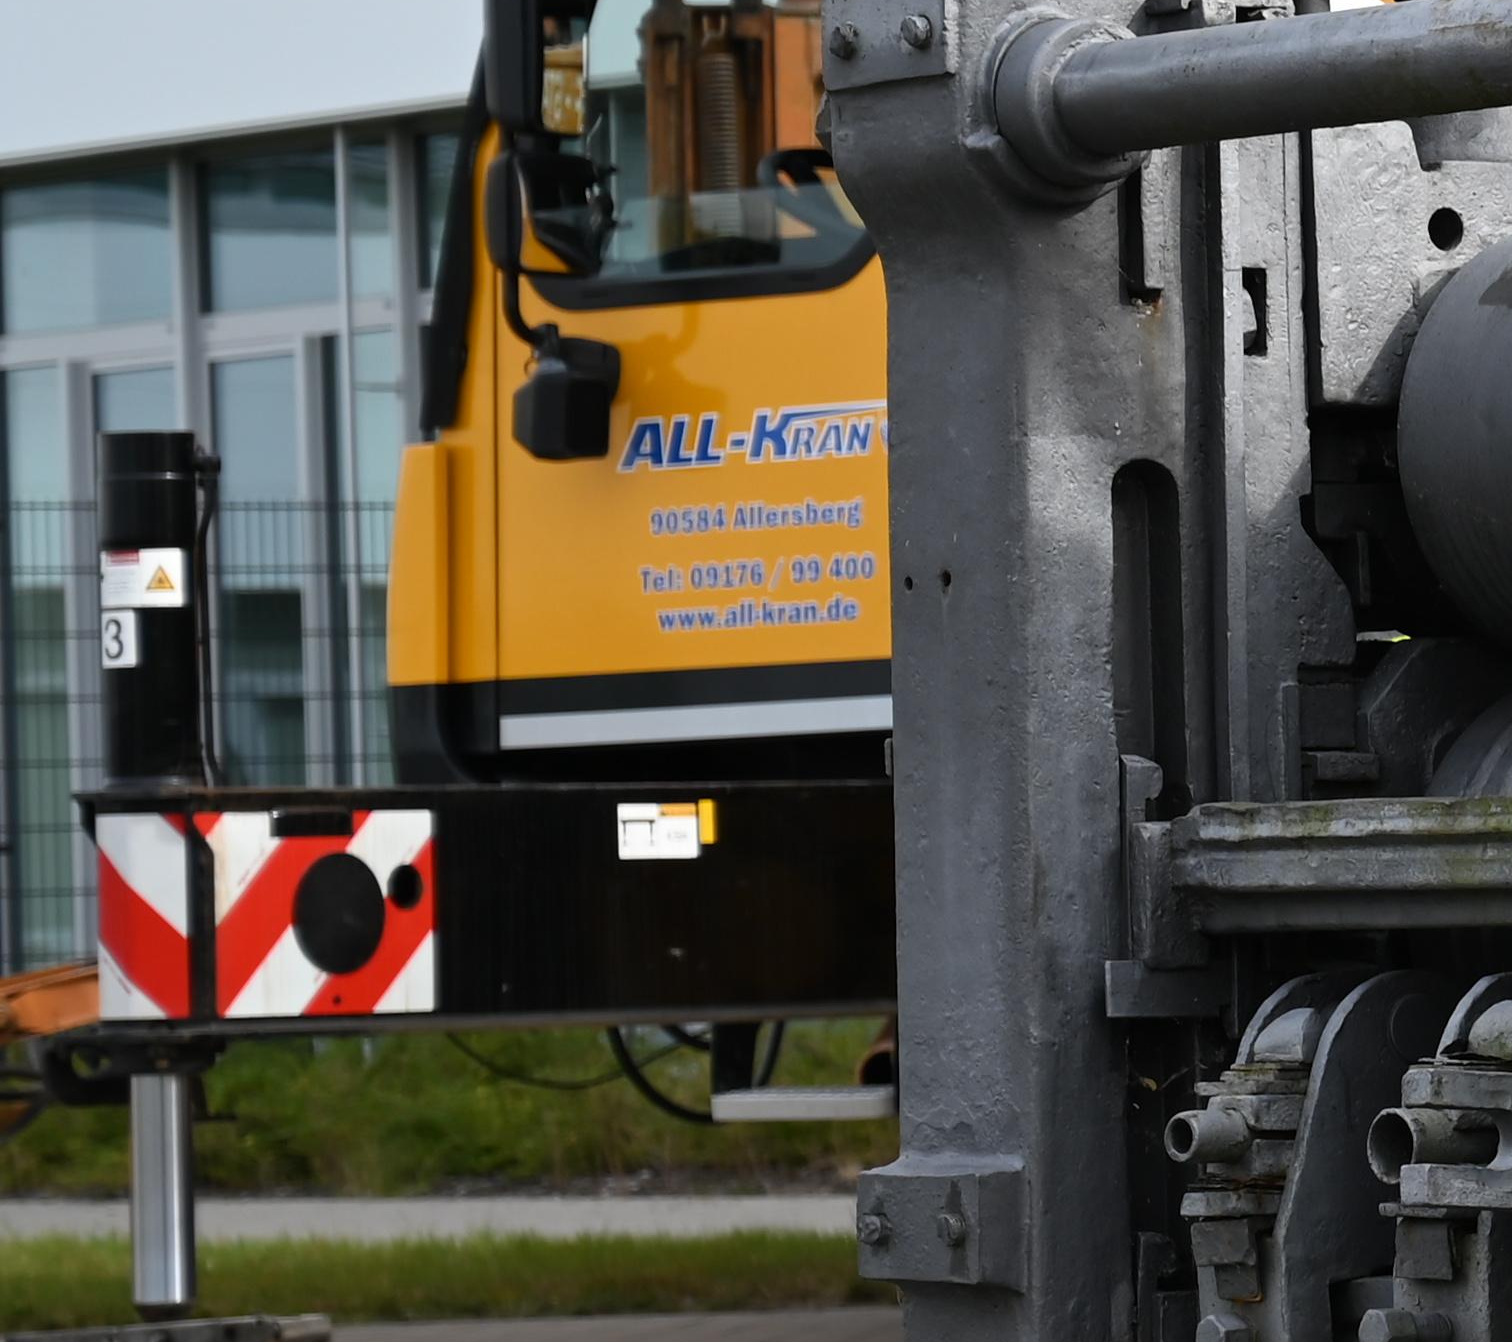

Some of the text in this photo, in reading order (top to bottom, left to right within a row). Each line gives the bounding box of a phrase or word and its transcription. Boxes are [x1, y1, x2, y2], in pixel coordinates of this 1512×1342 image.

[651, 497, 863, 535] 90584 Allersberg
[640, 566, 683, 594] Tel:
[690, 560, 763, 590] 09176
[790, 555, 821, 584] 99
[828, 552, 875, 581] 400
[658, 593, 859, 632] www.all-kran.de
[105, 618, 124, 660] 3
